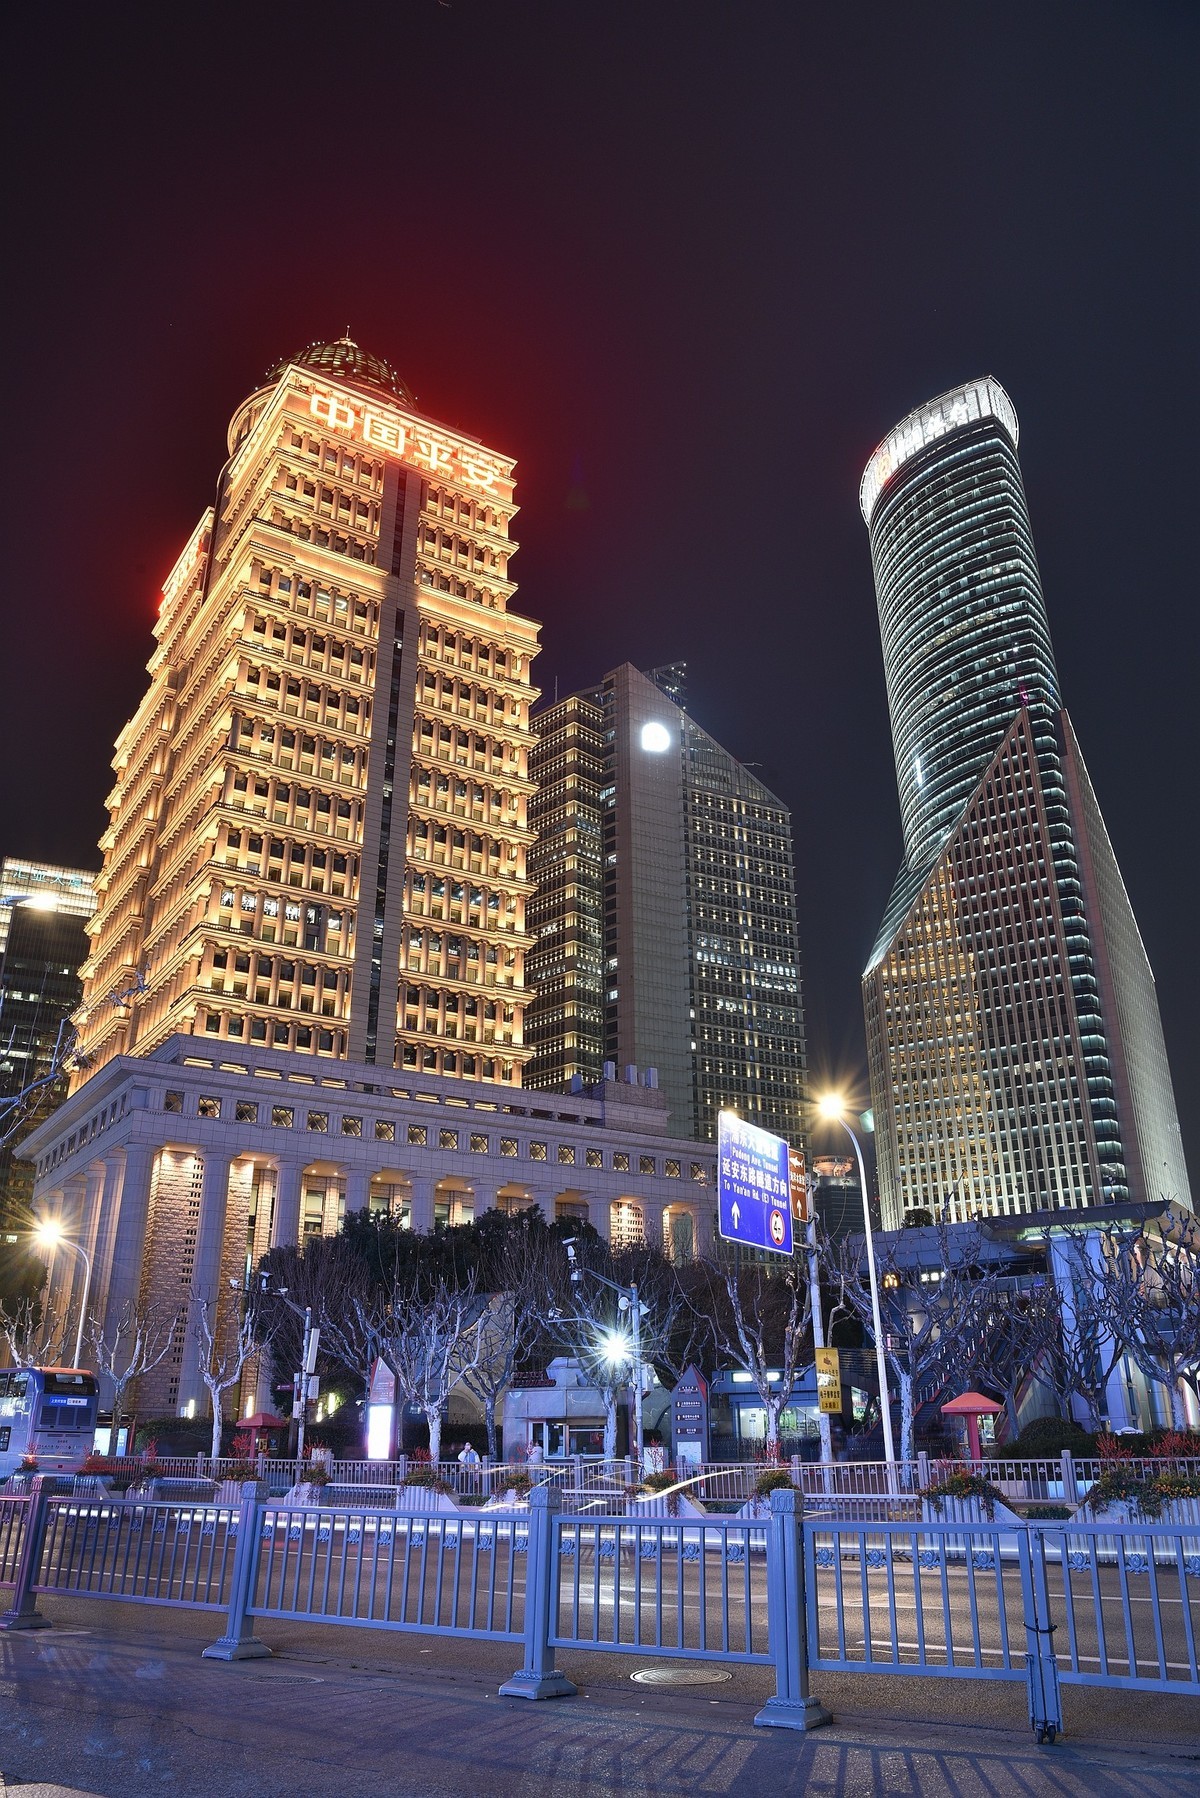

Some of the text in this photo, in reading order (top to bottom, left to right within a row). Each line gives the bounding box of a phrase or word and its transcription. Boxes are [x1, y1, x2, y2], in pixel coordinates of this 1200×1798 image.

[310, 394, 499, 495] 中国平安
[12, 866, 83, 887] 汇亚大厦
[732, 1147, 750, 1165] Pudong
[763, 1158, 778, 1173] Tunnel
[722, 1158, 787, 1197] 延安东路隧道方向
[723, 1180, 731, 1190] To
[771, 1196, 788, 1209] Tunnel
